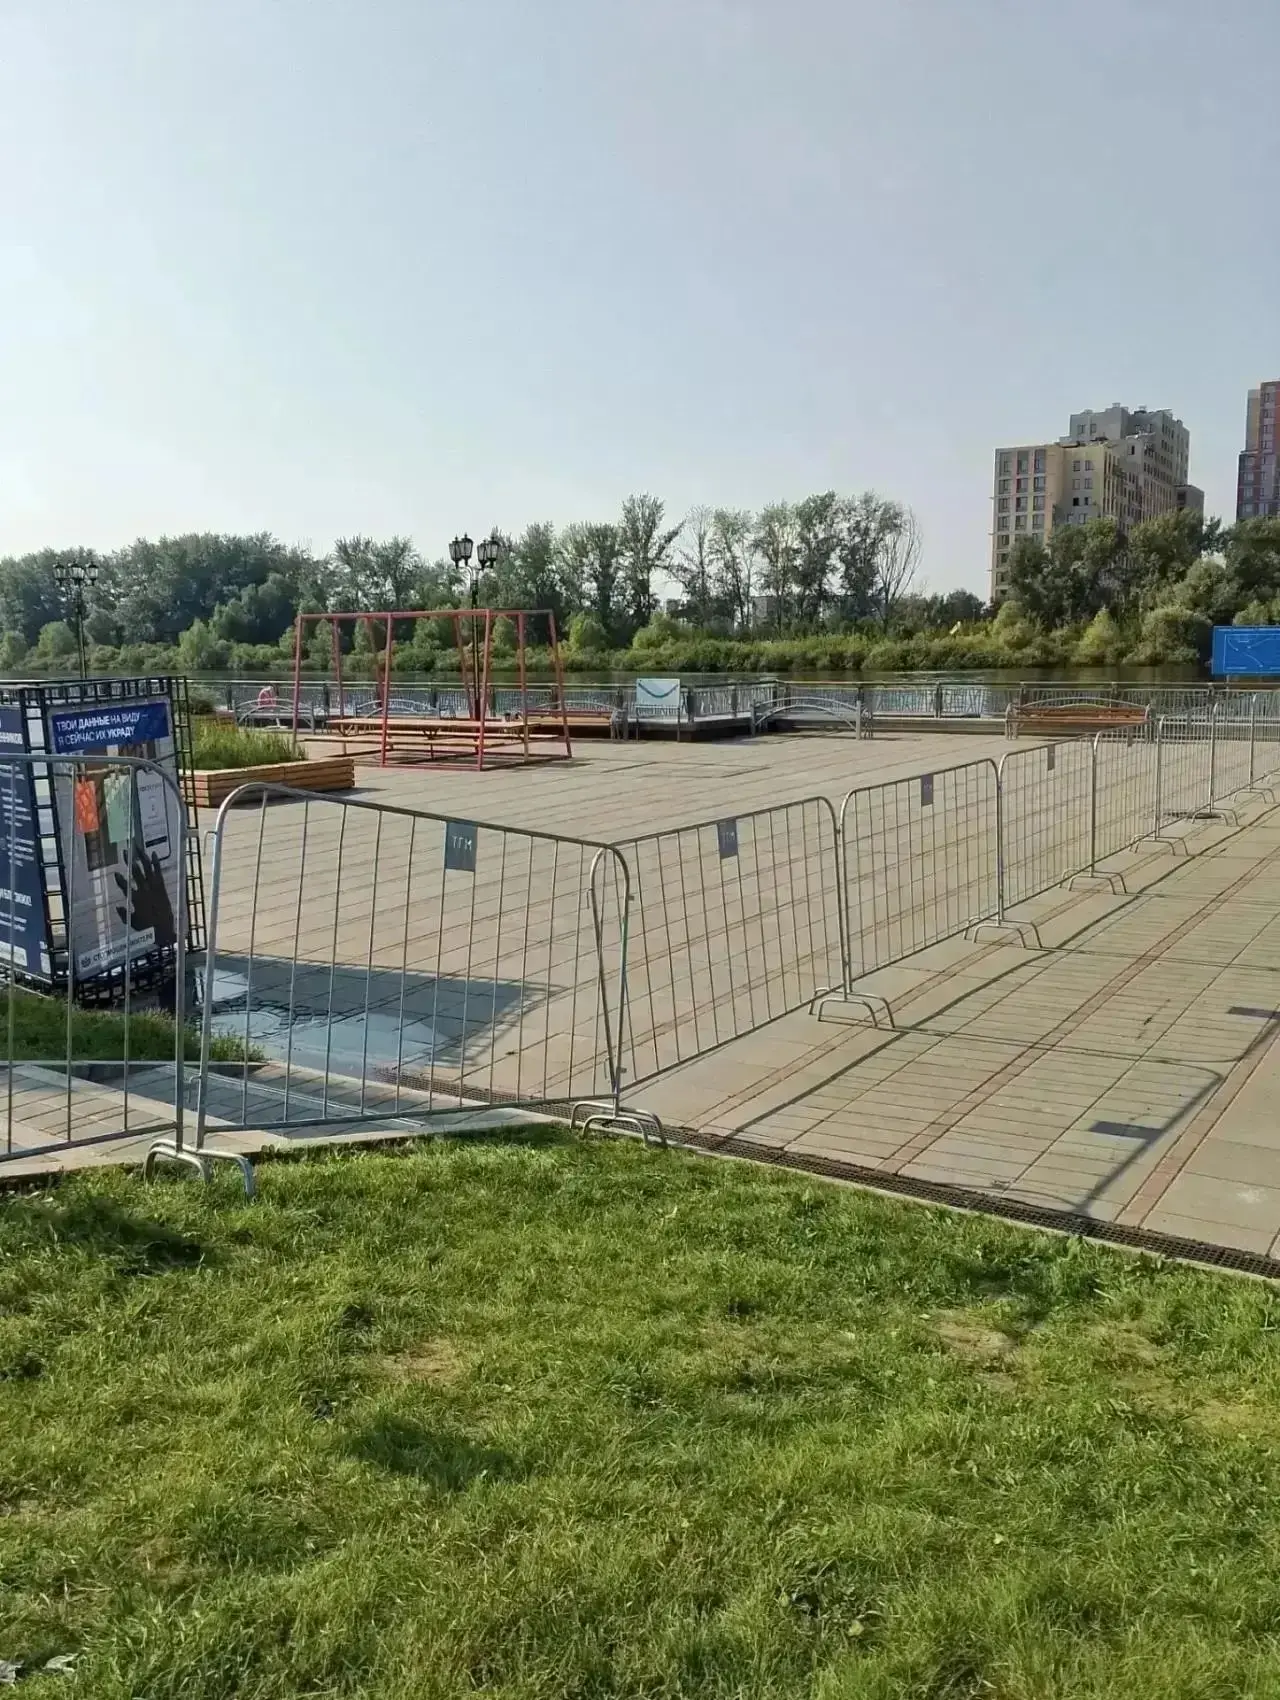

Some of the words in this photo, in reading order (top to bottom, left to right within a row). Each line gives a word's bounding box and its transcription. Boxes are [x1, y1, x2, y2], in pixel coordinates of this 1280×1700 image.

[56, 720, 78, 732] ТВОИ
[78, 715, 110, 729] ДАННЫЕ
[110, 713, 121, 724] НА
[121, 712, 140, 723] ВИДУ
[58, 736, 65, 746] Я
[65, 731, 95, 745] СЕЙЧАС
[95, 729, 106, 741] ИХ
[107, 726, 135, 739] УКРАДУ
